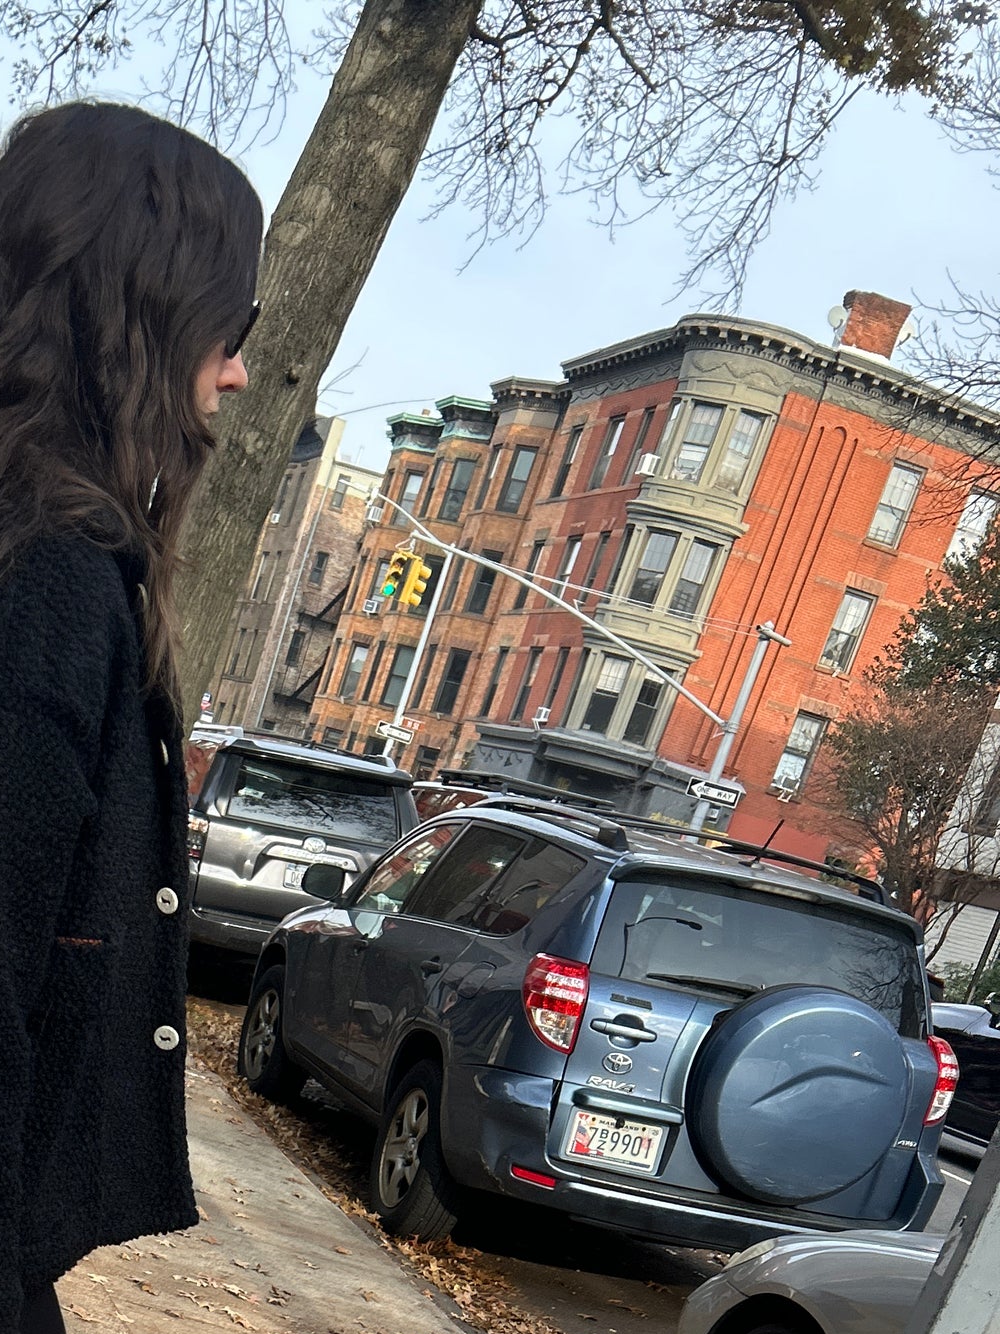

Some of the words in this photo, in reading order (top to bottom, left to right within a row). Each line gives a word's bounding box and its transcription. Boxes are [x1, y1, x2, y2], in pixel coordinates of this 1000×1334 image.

[696, 785, 712, 795] ONE
[716, 791, 734, 801] WAY
[586, 1075, 636, 1095] RAV4
[599, 1119, 641, 1132] MARAND
